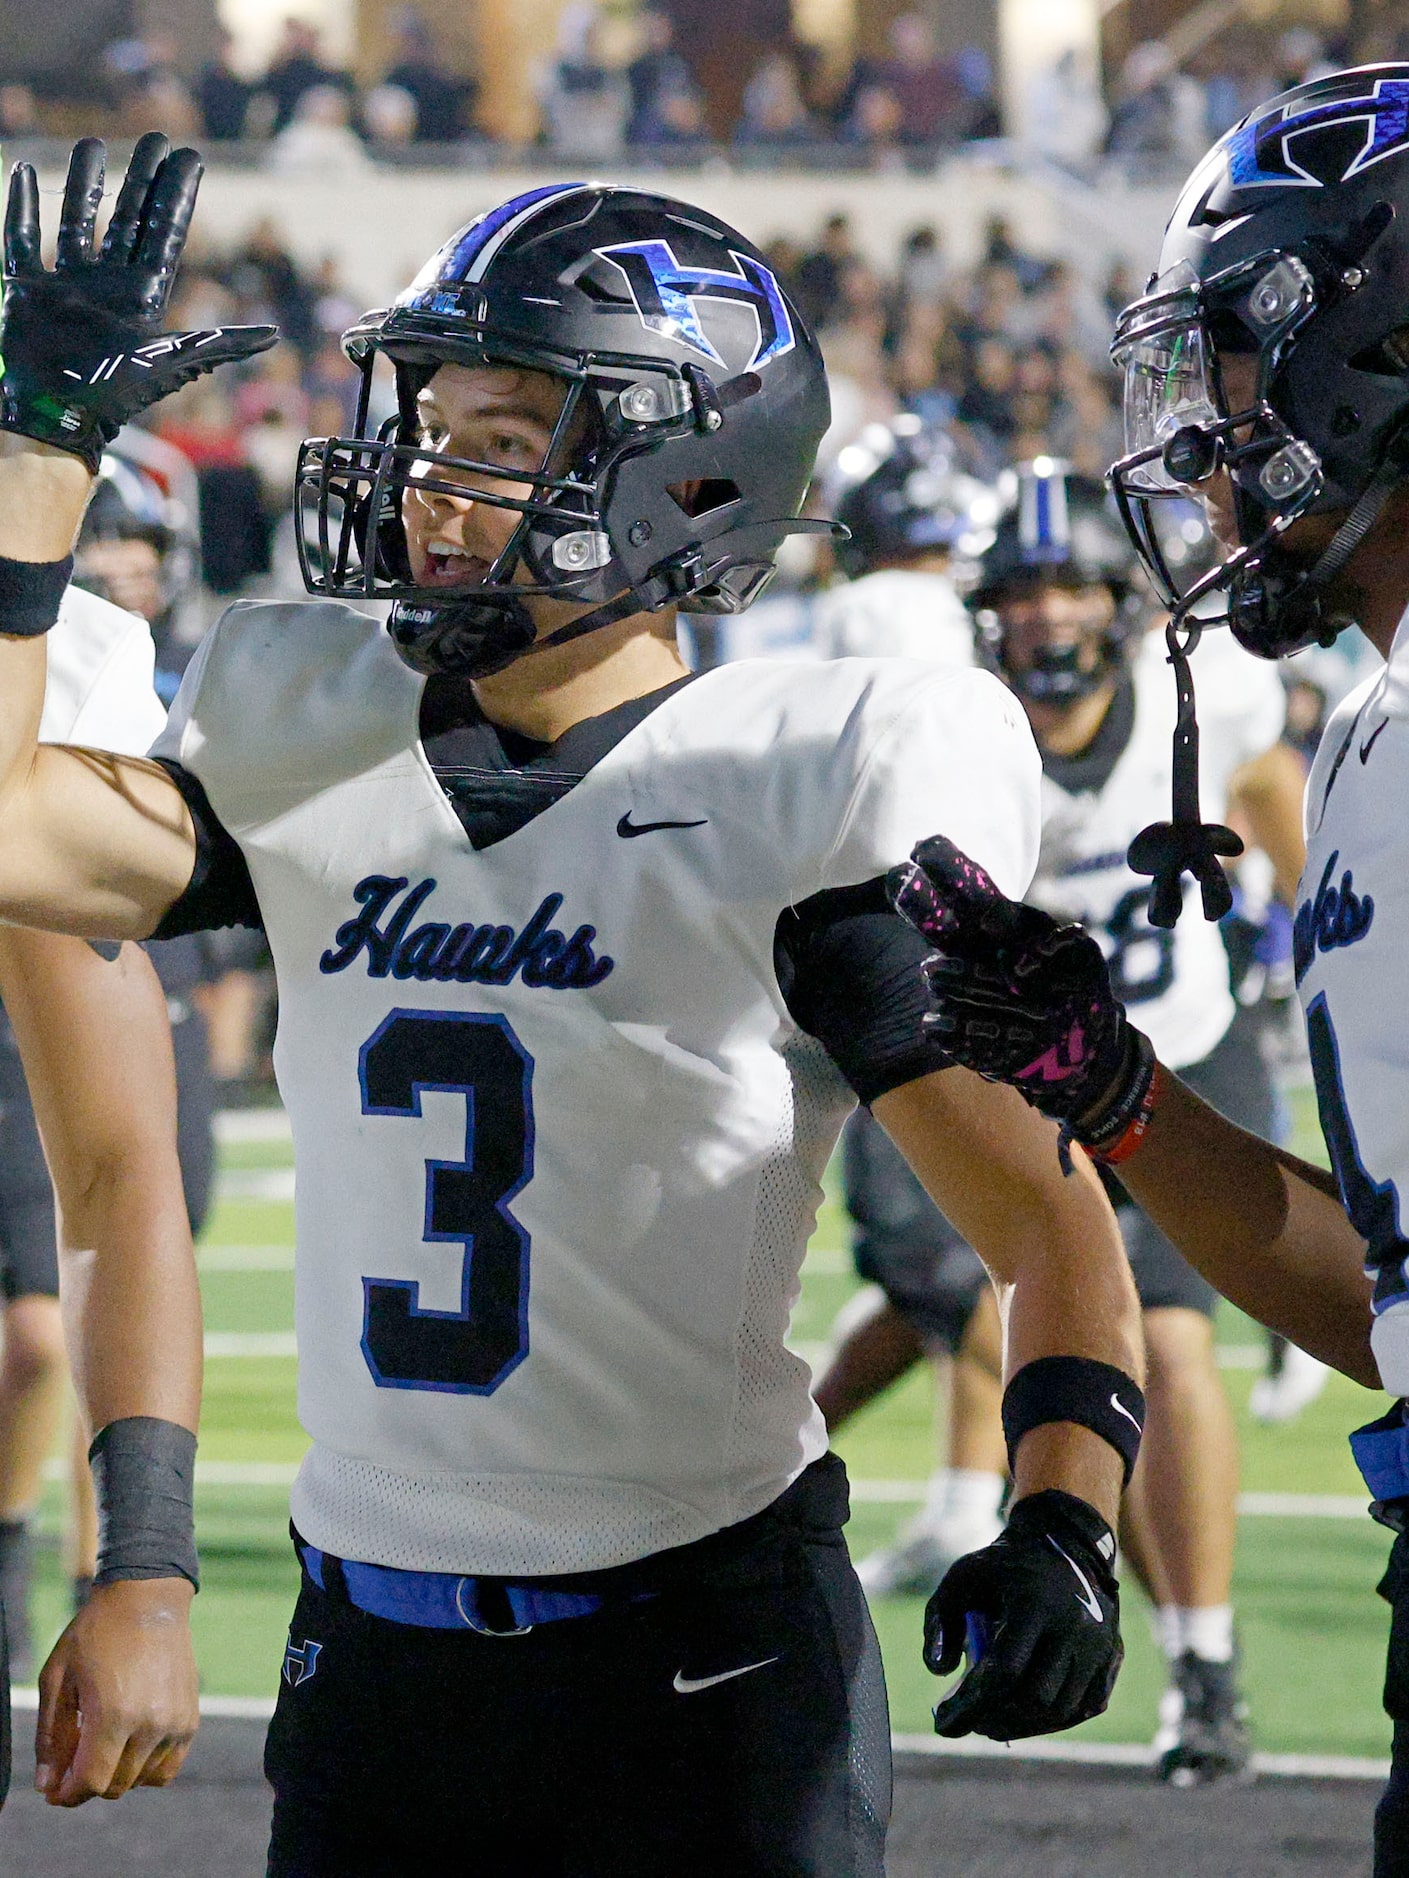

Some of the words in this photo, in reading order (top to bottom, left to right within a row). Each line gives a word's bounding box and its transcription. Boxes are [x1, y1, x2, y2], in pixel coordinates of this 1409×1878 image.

[592, 239, 797, 374] H
[320, 875, 614, 989] Hawks
[358, 1007, 535, 1397] 3
